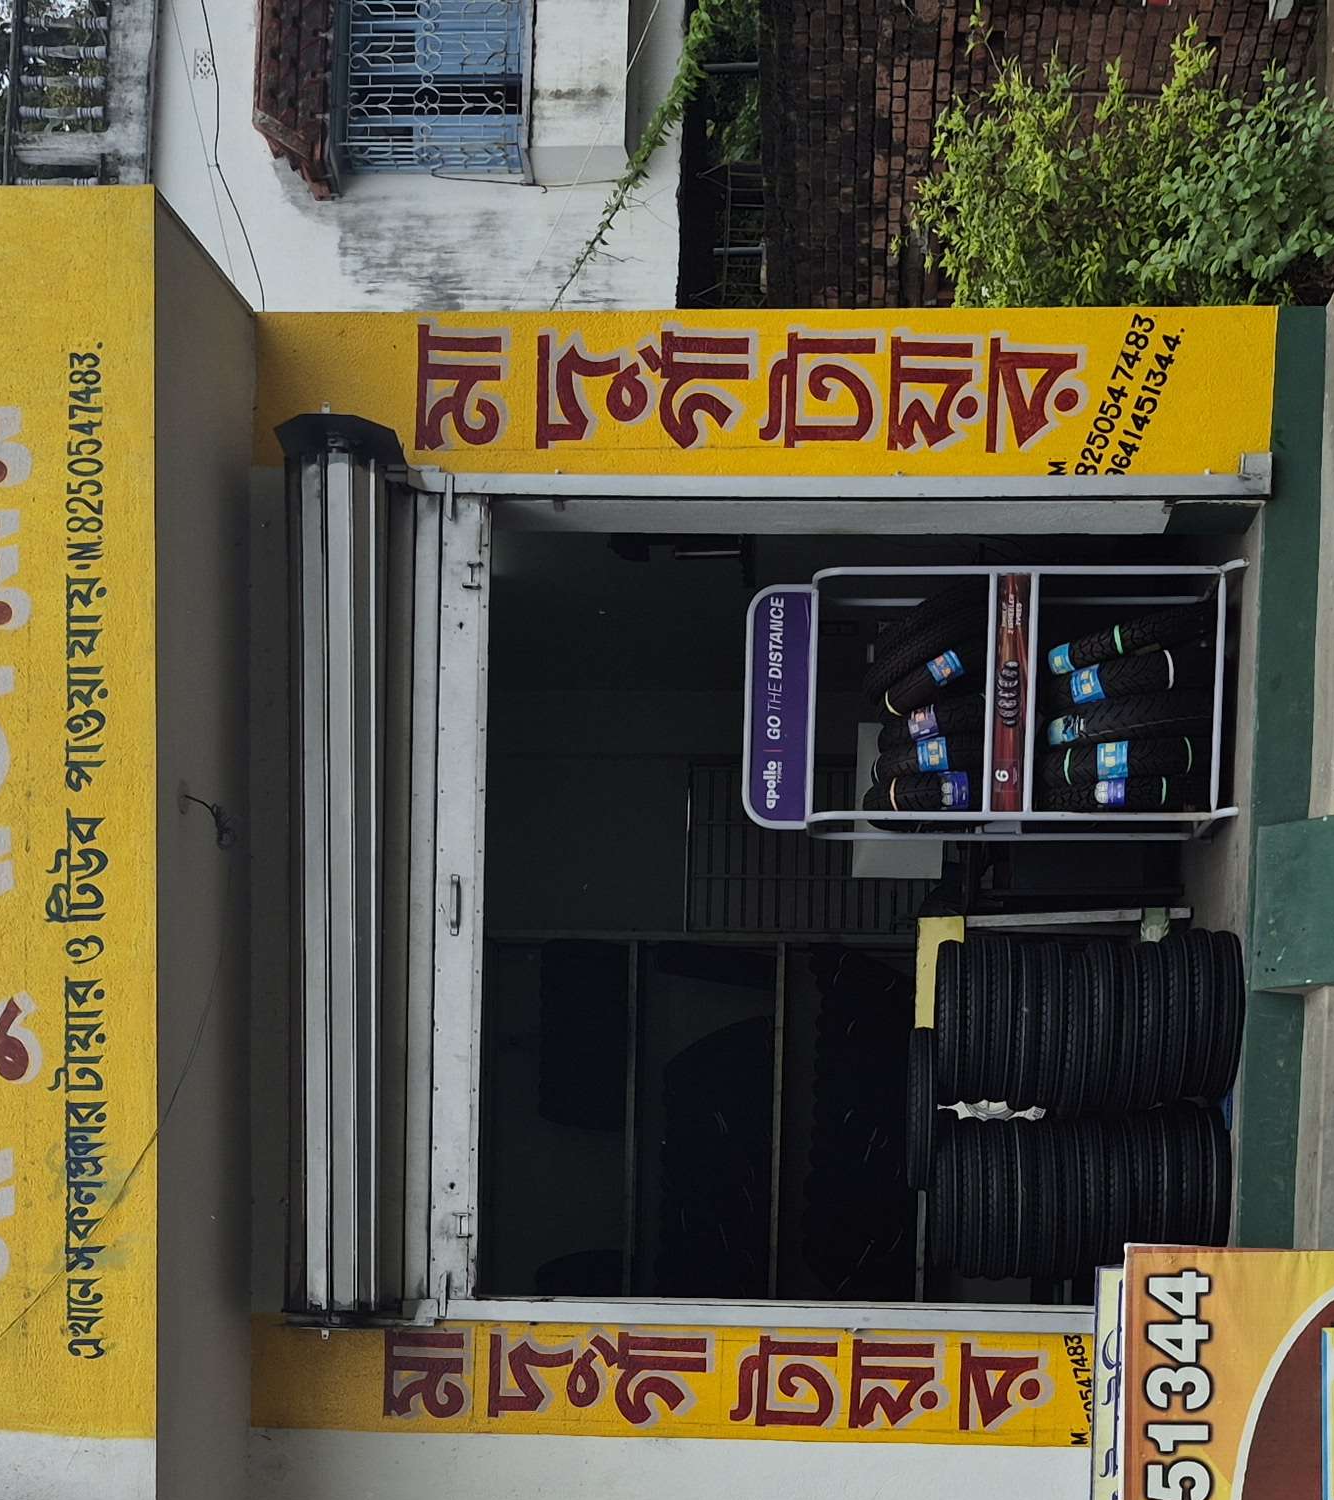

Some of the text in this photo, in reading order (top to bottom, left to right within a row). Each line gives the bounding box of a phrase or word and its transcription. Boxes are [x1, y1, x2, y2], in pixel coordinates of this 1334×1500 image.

[415, 323, 504, 451] মা
[766, 595, 785, 740] GO THE DISTANCE
[762, 760, 780, 810] apollo
[994, 769, 1009, 783] 6
[43, 806, 109, 924] টিউব
[64, 934, 105, 965] ও
[45, 975, 107, 1095] টায়ার
[63, 1276, 108, 1360] এখানে
[382, 1327, 466, 1419] মা
